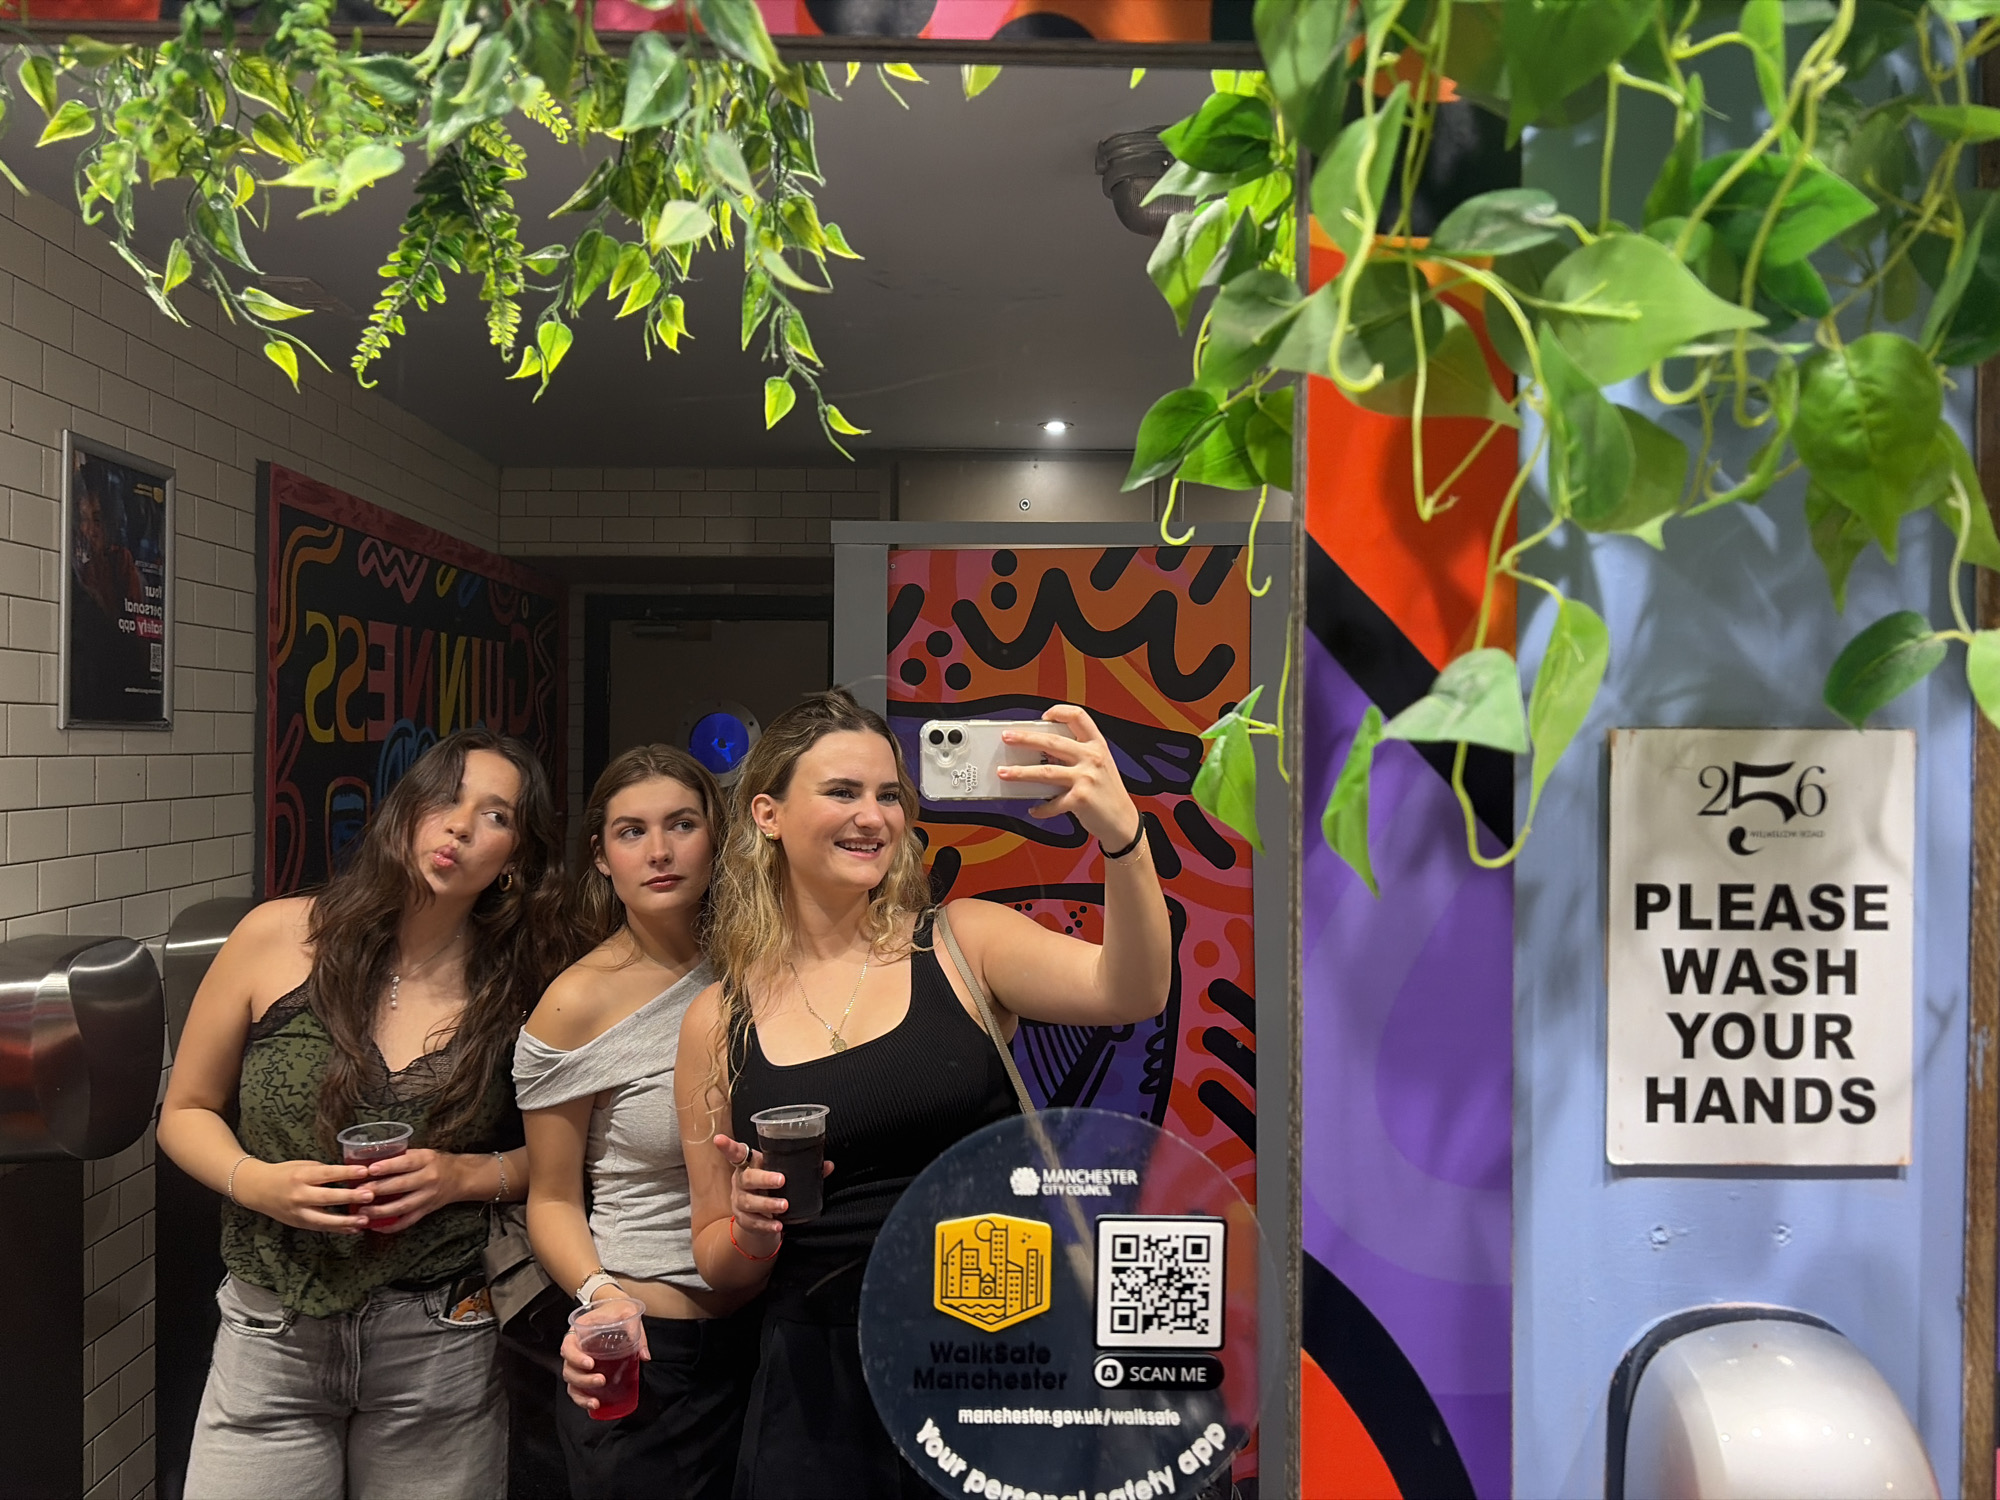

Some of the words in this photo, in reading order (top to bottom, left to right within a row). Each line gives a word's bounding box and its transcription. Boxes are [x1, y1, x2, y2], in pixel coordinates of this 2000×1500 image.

[1697, 761, 1828, 855] 256
[1635, 883, 1889, 931] PLEASE
[1662, 948, 1858, 996] WASH
[1667, 1012, 1855, 1060] YOUR
[1645, 1077, 1877, 1125] HANDS
[1041, 1183, 1065, 1196] CITY
[1066, 1184, 1111, 1196] COUNCIL
[1042, 1168, 1138, 1185] MANCHESTER
[929, 1340, 1052, 1364] WalkSafe
[913, 1366, 1068, 1390] Manchester
[1129, 1366, 1176, 1382] SCAN
[1180, 1367, 1207, 1383] ME
[958, 1406, 1181, 1428] manchester.gov.uk/walksafe
[916, 1417, 967, 1478] Your
[1177, 1422, 1226, 1474] app
